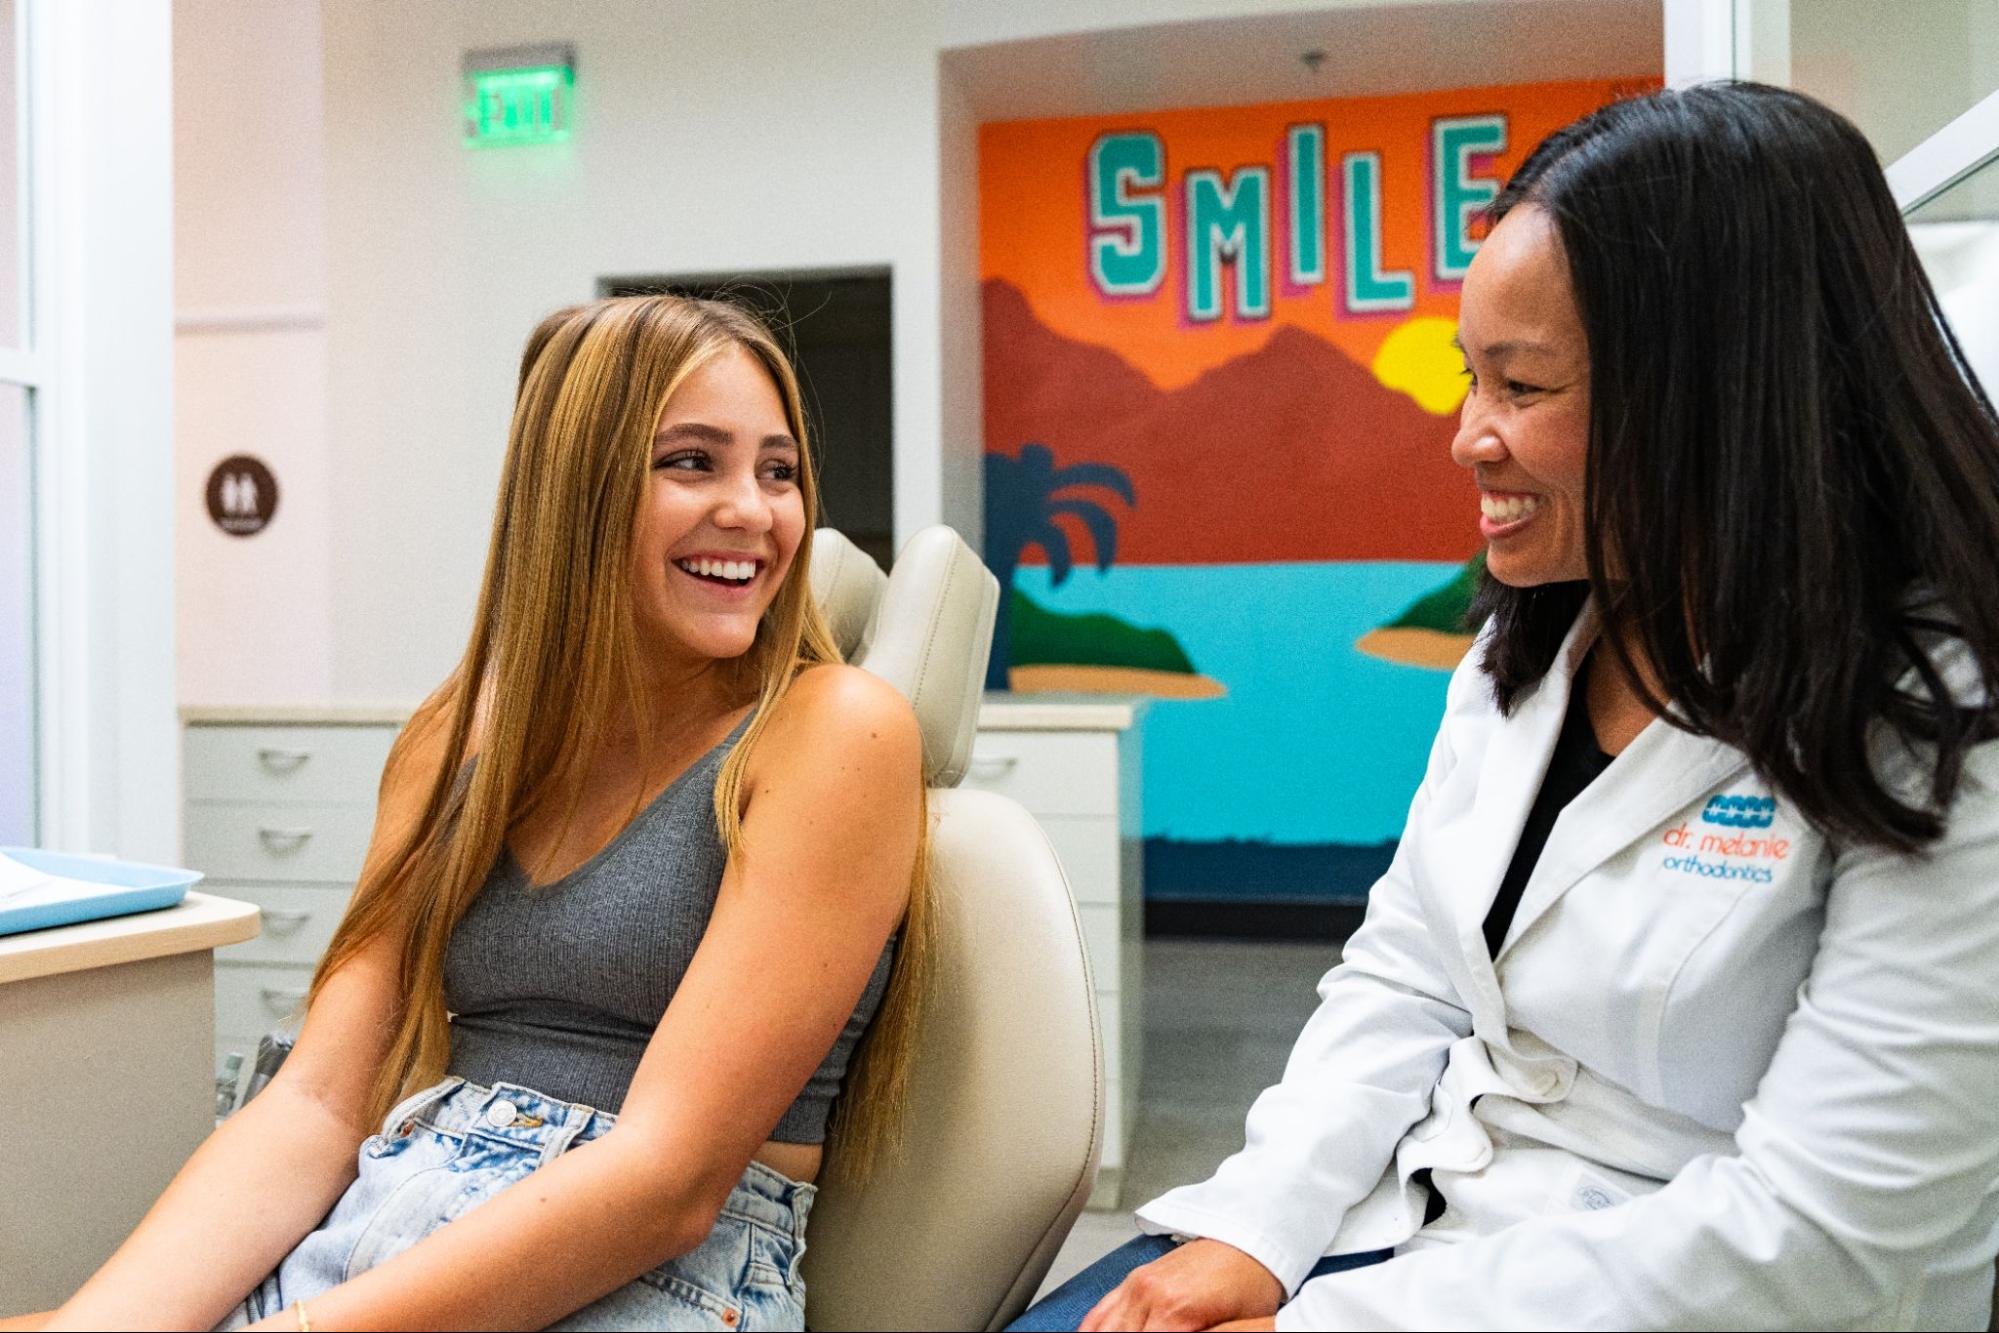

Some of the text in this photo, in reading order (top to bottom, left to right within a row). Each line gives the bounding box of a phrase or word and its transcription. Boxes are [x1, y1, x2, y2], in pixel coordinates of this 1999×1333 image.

[1088, 114, 1508, 320] SMILE
[1663, 822, 1790, 860] dr. melanie
[1663, 855, 1773, 884] orthodontics
